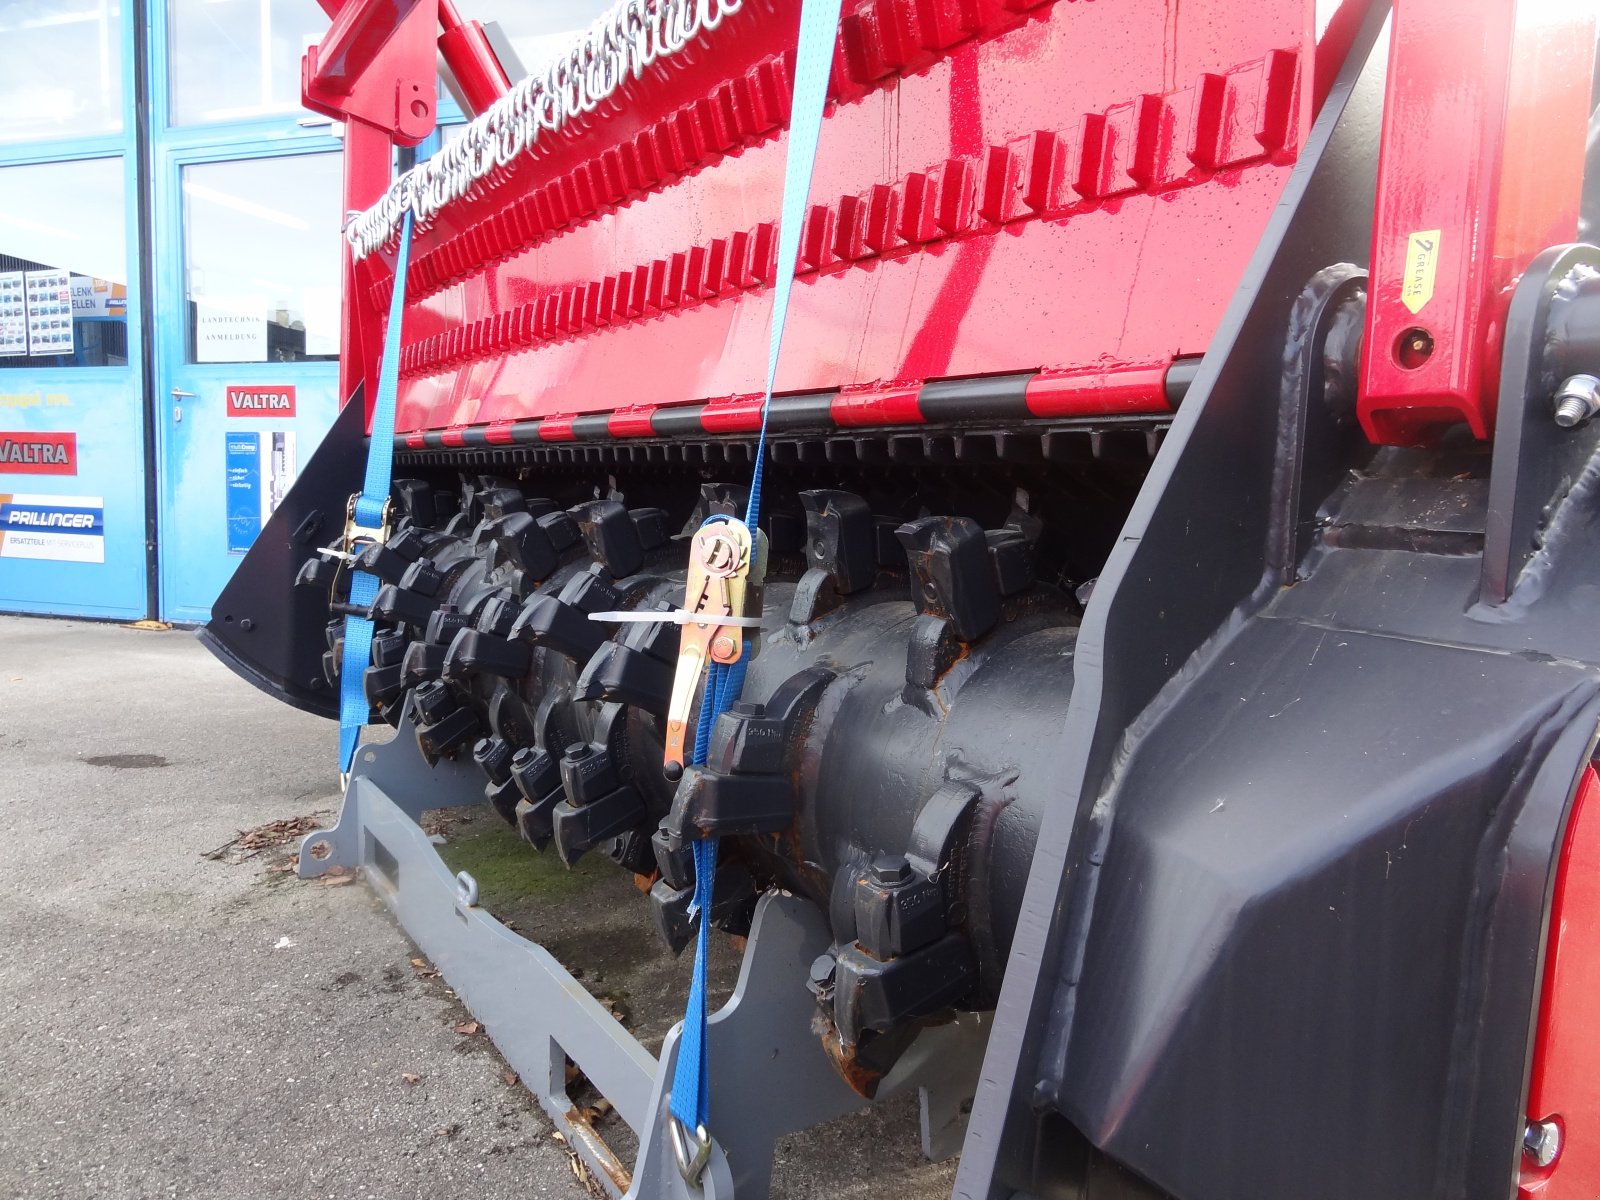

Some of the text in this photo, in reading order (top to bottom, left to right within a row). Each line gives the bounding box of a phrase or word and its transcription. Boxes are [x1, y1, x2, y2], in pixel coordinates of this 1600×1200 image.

[1413, 253, 1425, 296] GREASE
[206, 333, 257, 341] ANMELDUNG
[229, 390, 291, 410] VALTRA
[0, 439, 69, 465] VALTRA
[8, 510, 95, 529] PRILLINGER
